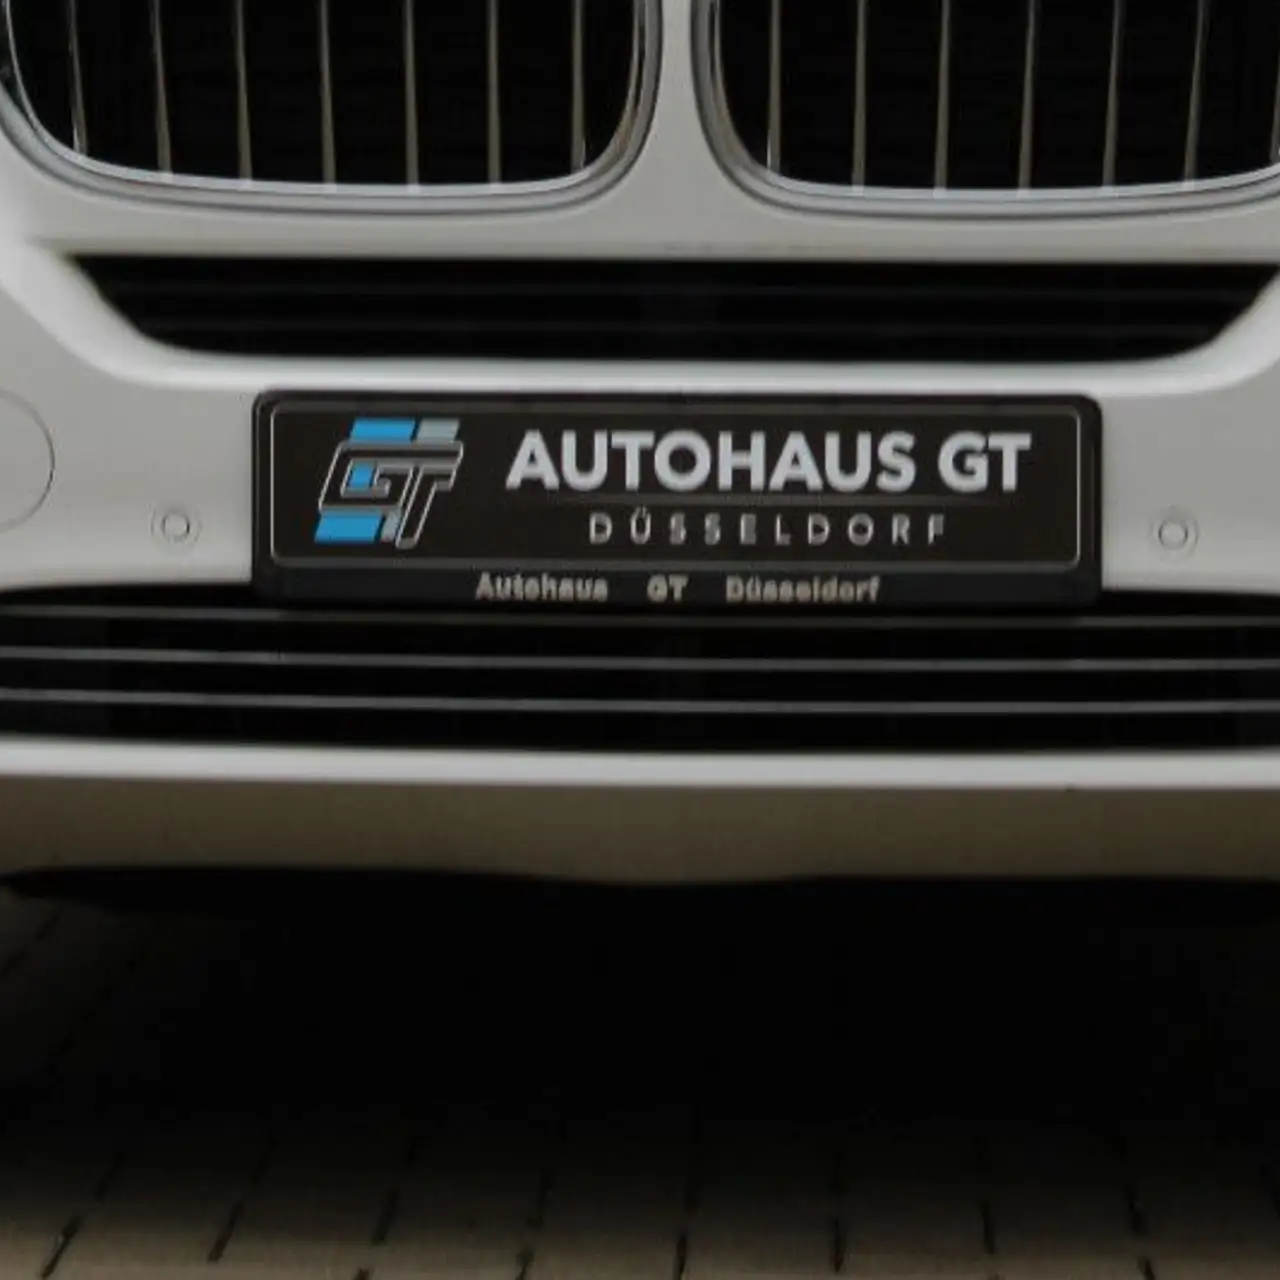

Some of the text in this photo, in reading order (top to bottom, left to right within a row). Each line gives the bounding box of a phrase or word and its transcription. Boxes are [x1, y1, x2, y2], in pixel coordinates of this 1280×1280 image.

[506, 431, 1032, 492] AUTOHAUS GT
[589, 508, 945, 546] DÜSSELDORF
[474, 572, 882, 604] Autohaus GT Düsseldorf
